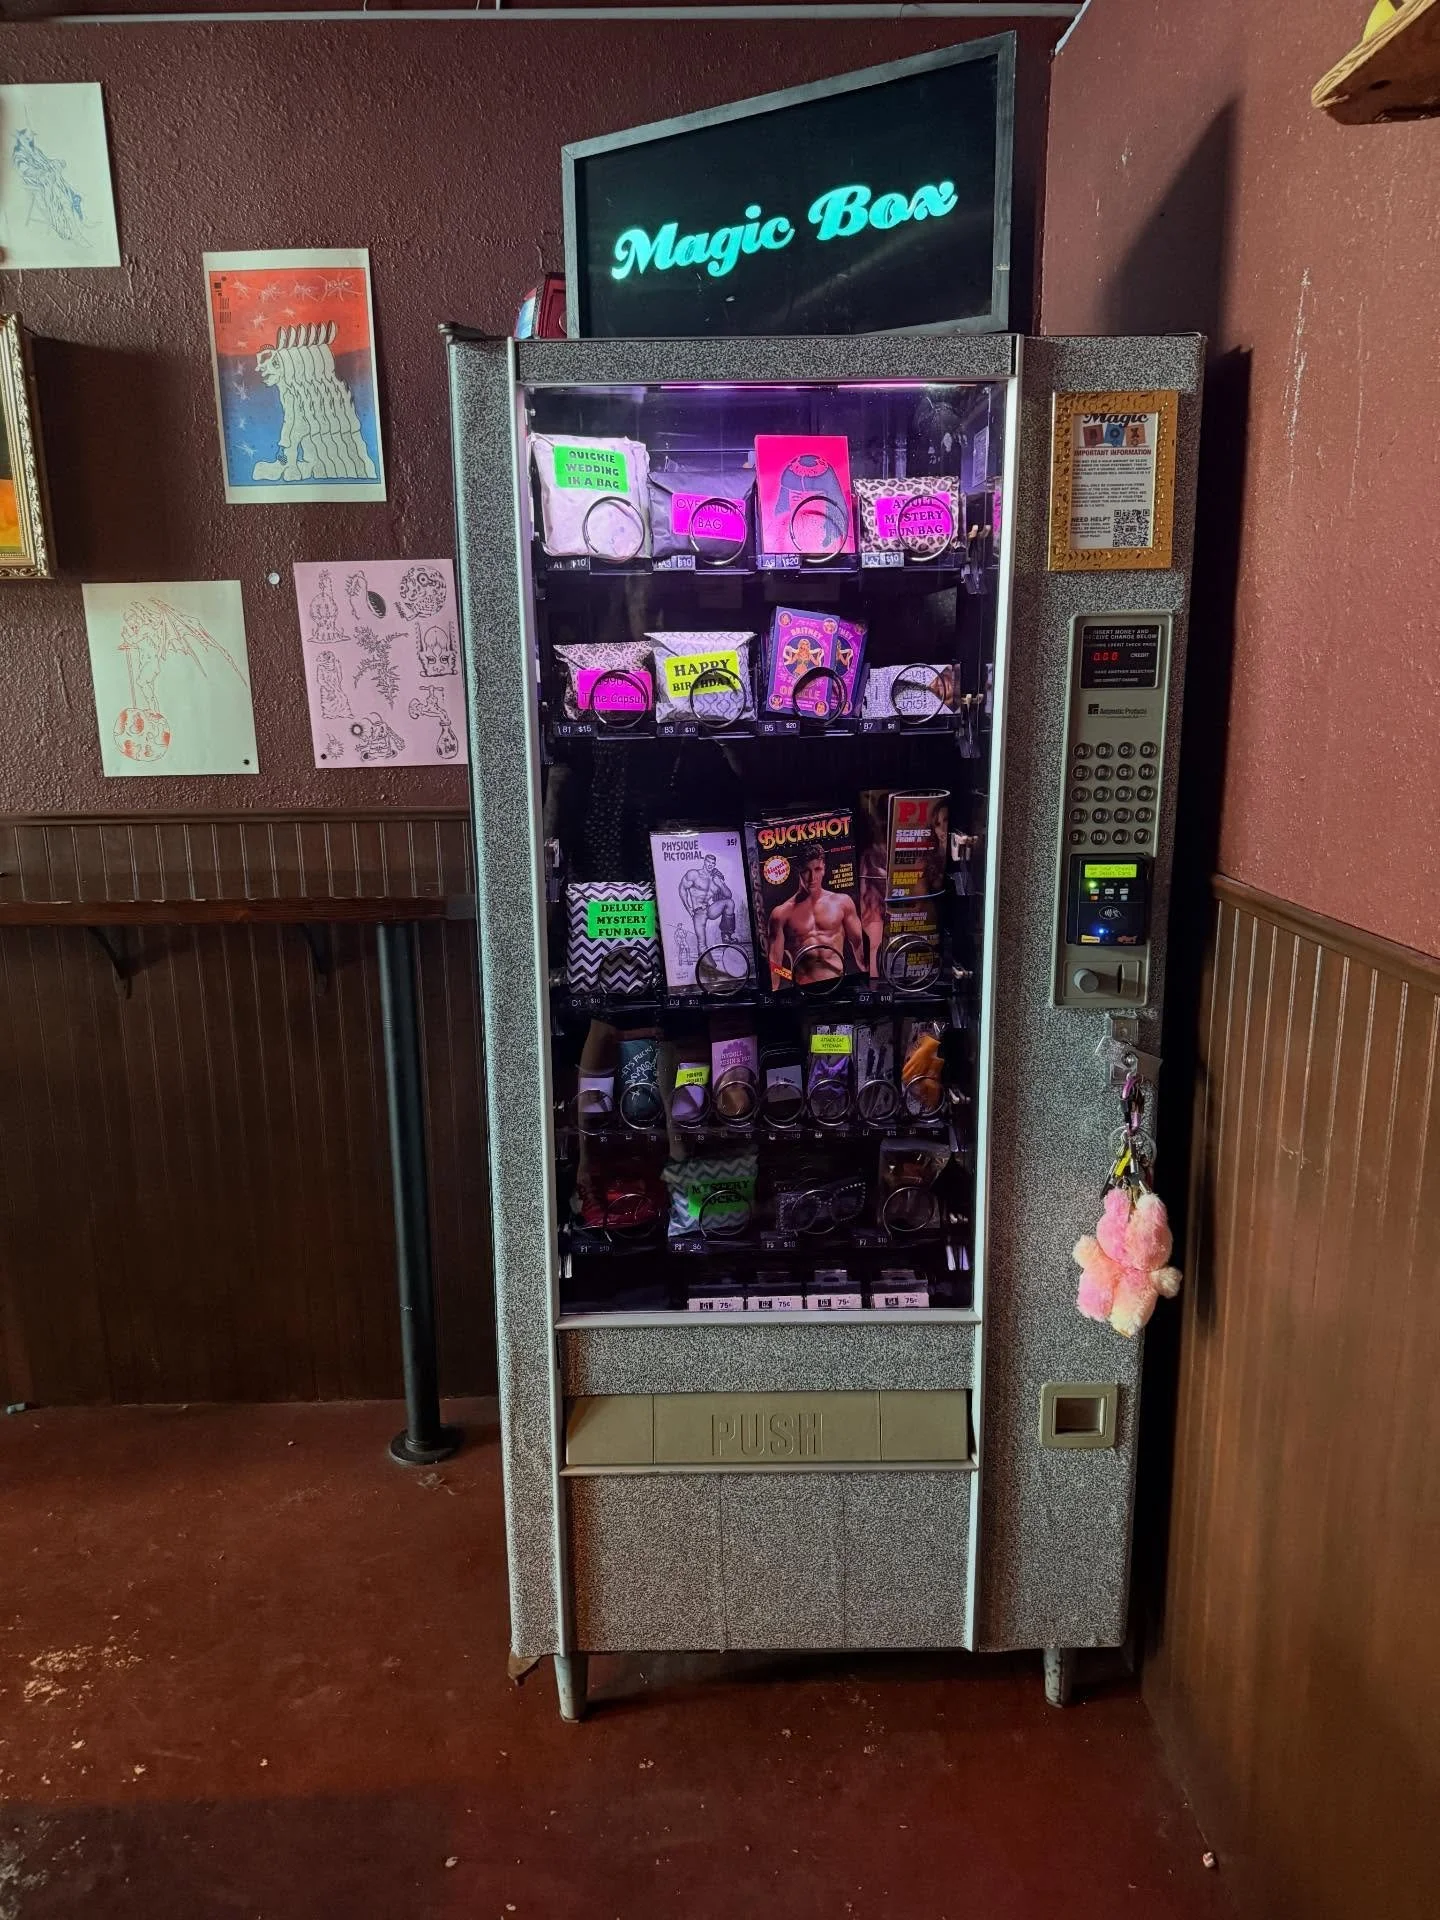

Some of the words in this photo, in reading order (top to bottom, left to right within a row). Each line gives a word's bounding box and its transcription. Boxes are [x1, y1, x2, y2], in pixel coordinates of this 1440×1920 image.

[611, 204, 794, 280] Magic
[807, 180, 958, 241] Box
[1083, 413, 1149, 428] Magic
[569, 450, 617, 467] QUICKIE
[1074, 449, 1109, 457] IMPORTANT
[1110, 448, 1152, 456] INFORMATION
[565, 462, 620, 478] WEDDING
[567, 476, 581, 486] IN
[585, 477, 593, 486] A
[597, 477, 620, 490] BAG
[698, 517, 722, 530] BAG
[885, 511, 943, 524] MSTERY
[918, 524, 944, 536] BAG
[673, 659, 731, 677] HAPPY
[672, 676, 737, 691] BIRHDAY!
[582, 693, 607, 704] Tme
[611, 693, 648, 706] Capsul
[664, 726, 674, 734] B3
[1099, 746, 1107, 755] B
[1121, 745, 1129, 754] C
[1142, 745, 1150, 754] D
[1076, 768, 1084, 777] E
[1120, 768, 1128, 776] G
[1141, 767, 1149, 777] H
[898, 801, 929, 822] PI
[757, 815, 853, 851] BUCKSHOT
[895, 829, 932, 838] SCENES
[1072, 832, 1080, 841] 9
[1093, 832, 1104, 841] 10
[661, 840, 699, 852] PHYSIQUE
[664, 851, 705, 863] PICTORIAL
[601, 903, 645, 914] DELUXE
[597, 916, 648, 926] MYSTERY
[599, 928, 621, 938] FUN
[624, 927, 646, 937] BAG
[711, 1412, 824, 1457] PUSH
